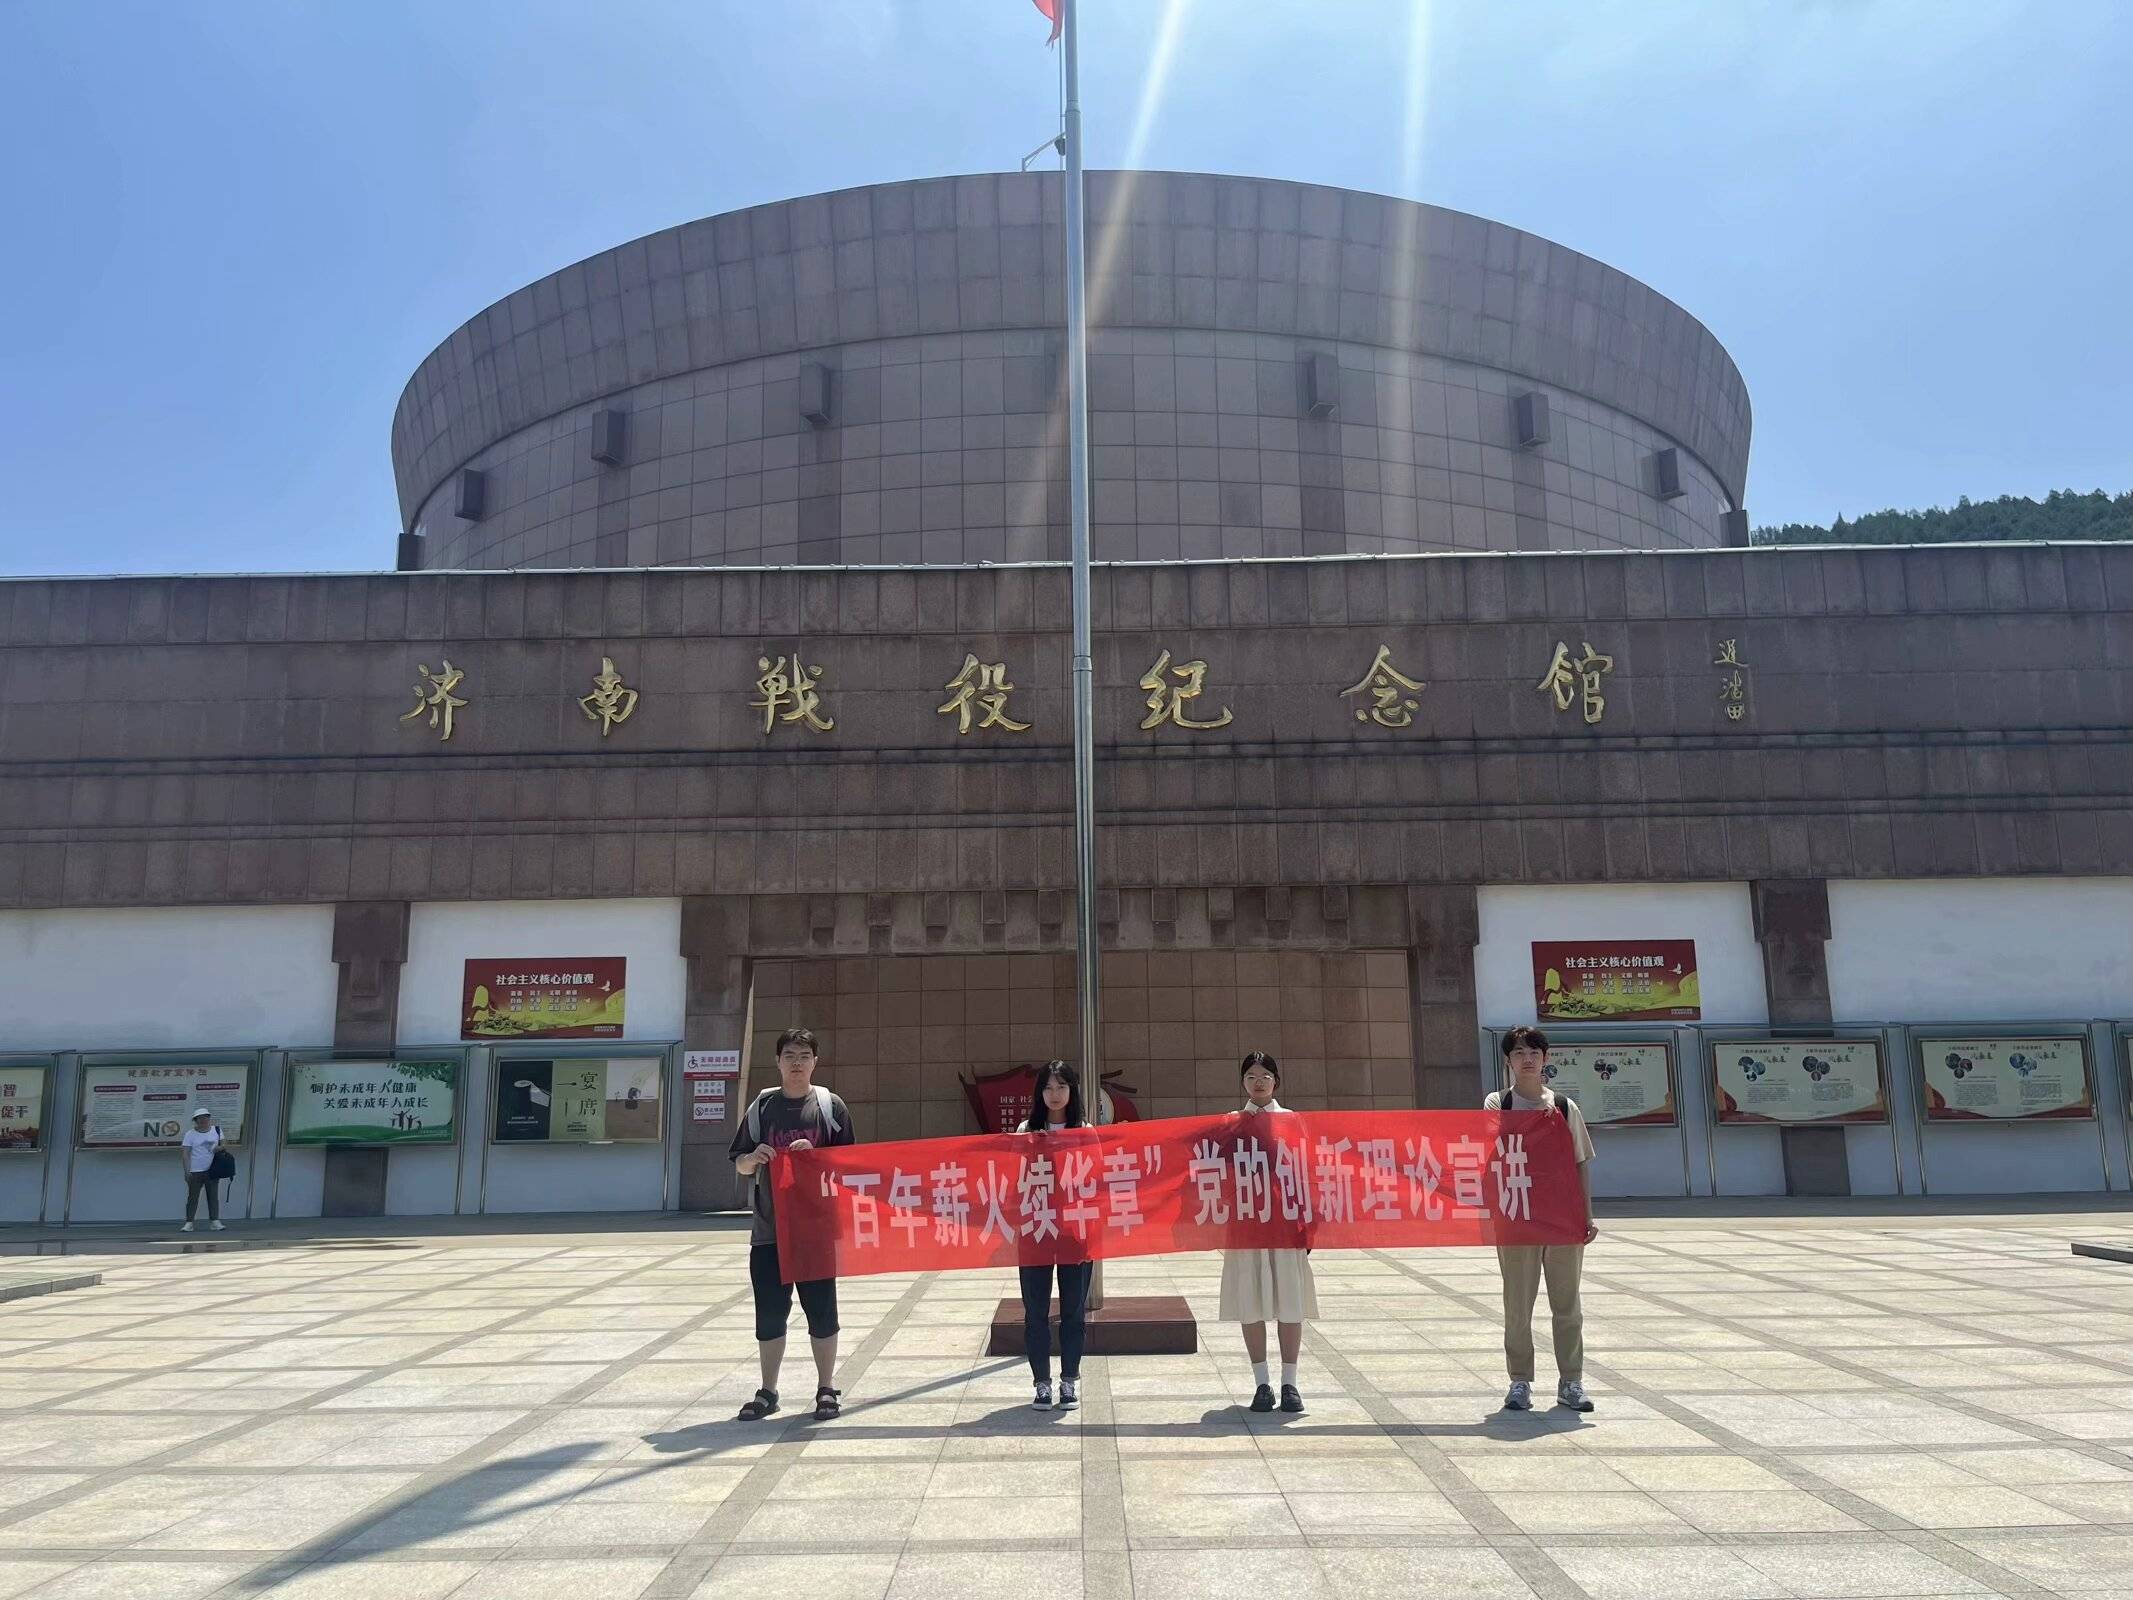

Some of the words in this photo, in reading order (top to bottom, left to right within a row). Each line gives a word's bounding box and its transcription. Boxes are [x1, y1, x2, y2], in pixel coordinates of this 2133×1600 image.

[398, 640, 1614, 741] 济南战役纪念馆
[1565, 955, 1665, 968] 社会主义核心价值观
[495, 973, 595, 986] 社会主义核心价值观
[324, 1097, 429, 1109] 关爱未成年人成长
[1188, 1134, 1533, 1226] 党的创新理论宣讲
